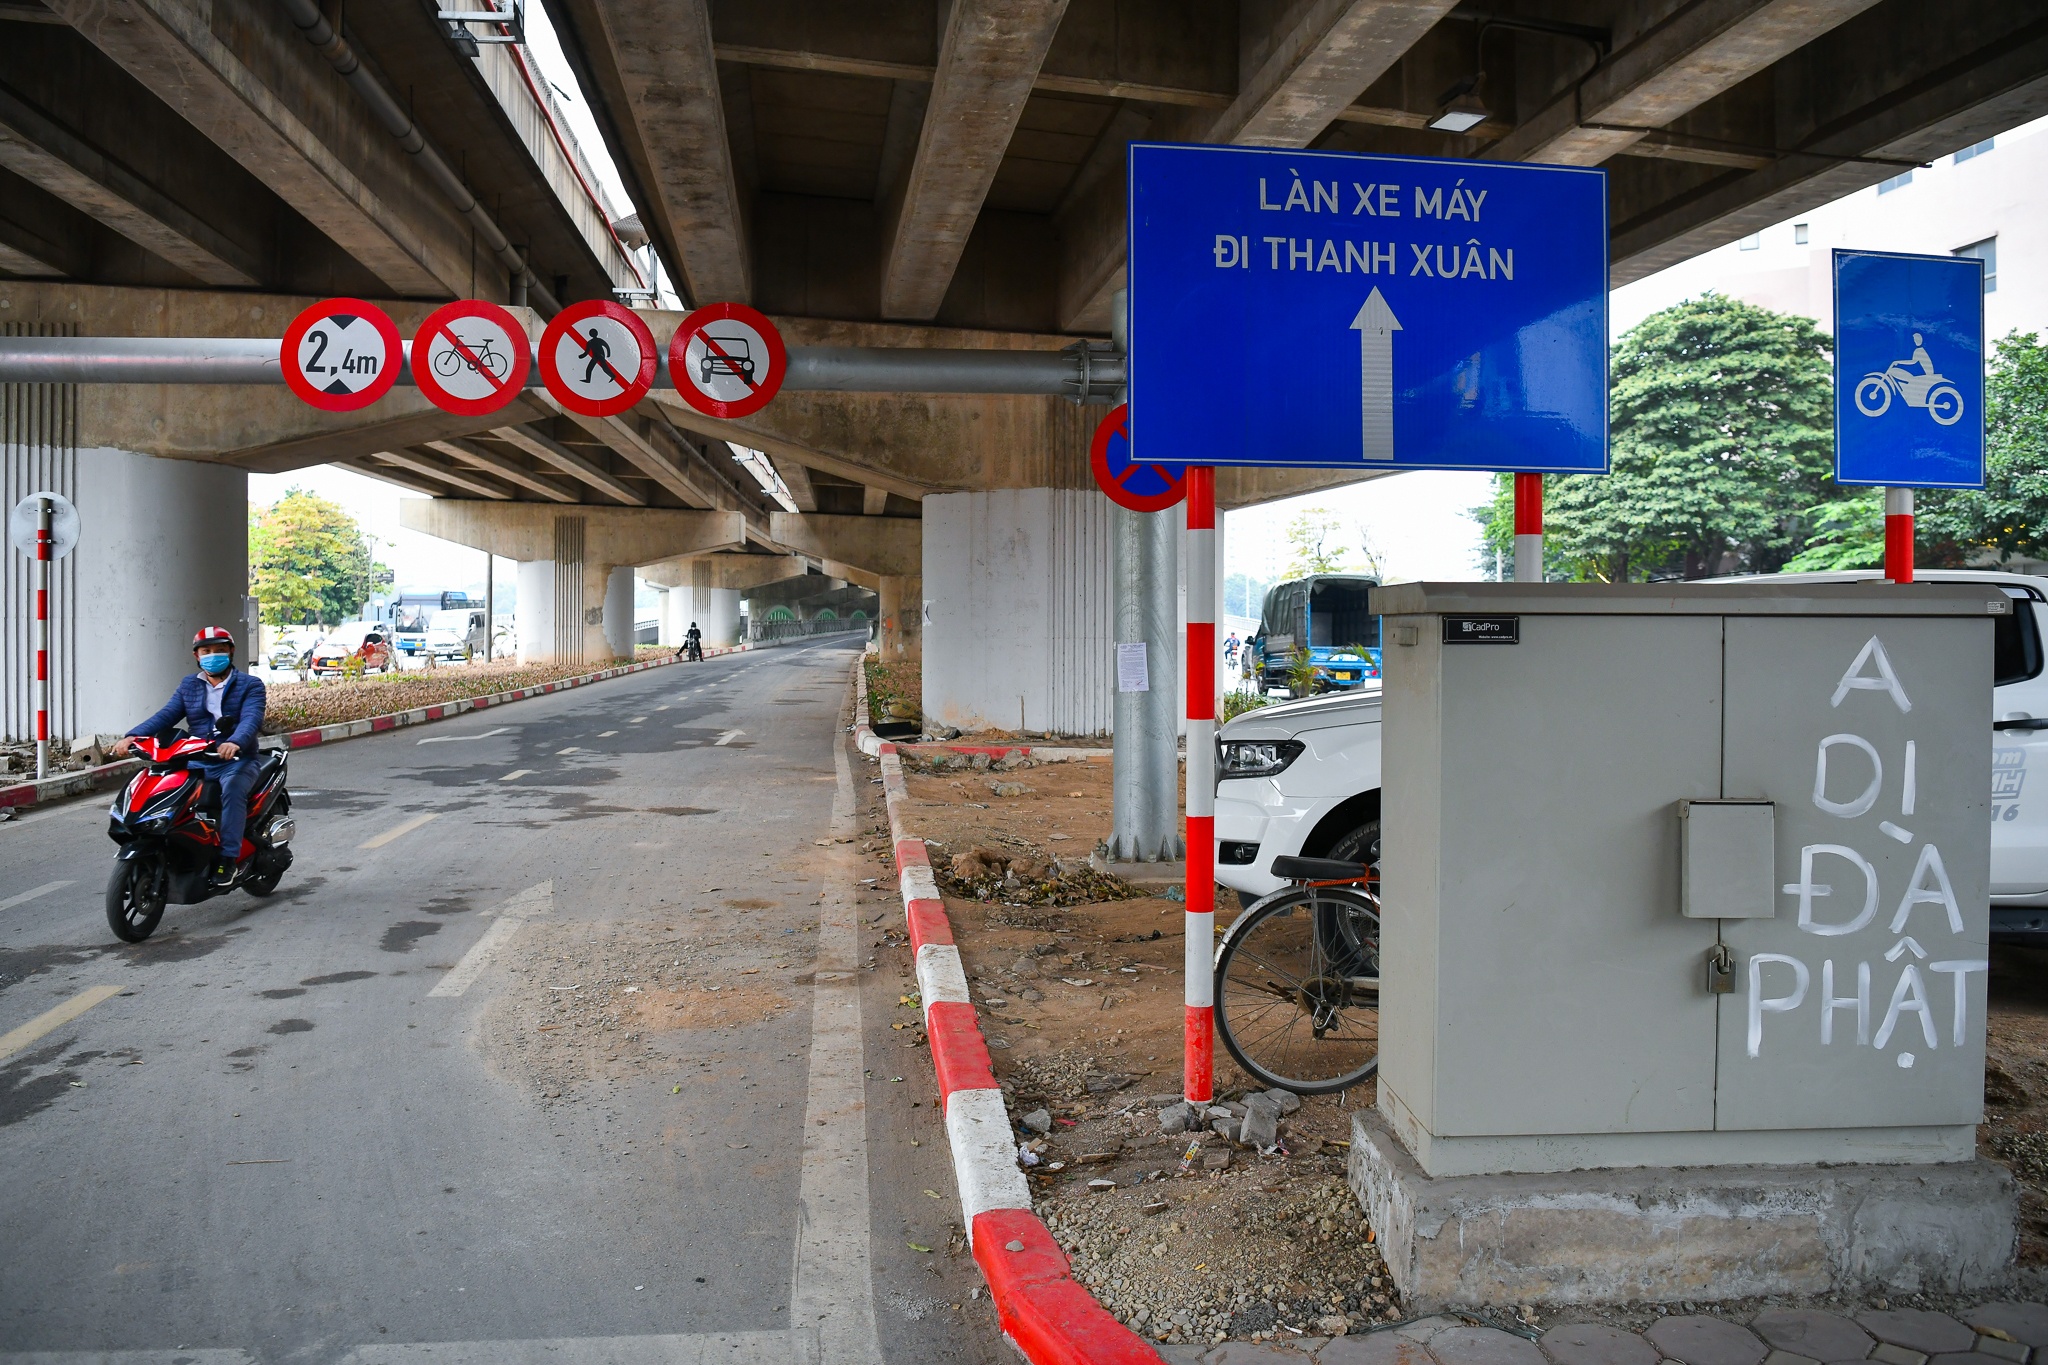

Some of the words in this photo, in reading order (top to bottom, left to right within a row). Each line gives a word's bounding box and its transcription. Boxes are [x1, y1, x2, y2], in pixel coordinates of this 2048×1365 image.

[1259, 168, 1339, 214] LÀN
[1352, 182, 1401, 217] XE
[1415, 178, 1488, 222] MÁY
[1213, 234, 1249, 269] ĐI
[1263, 236, 1397, 275] THANH
[1409, 238, 1514, 281] XUÂN
[305, 330, 378, 377] 2,4m
[1471, 622, 1500, 631] CadPro
[1830, 634, 1913, 714] A
[1781, 820, 1964, 936] ĐÀ
[1746, 936, 1990, 1069] PHẬT
